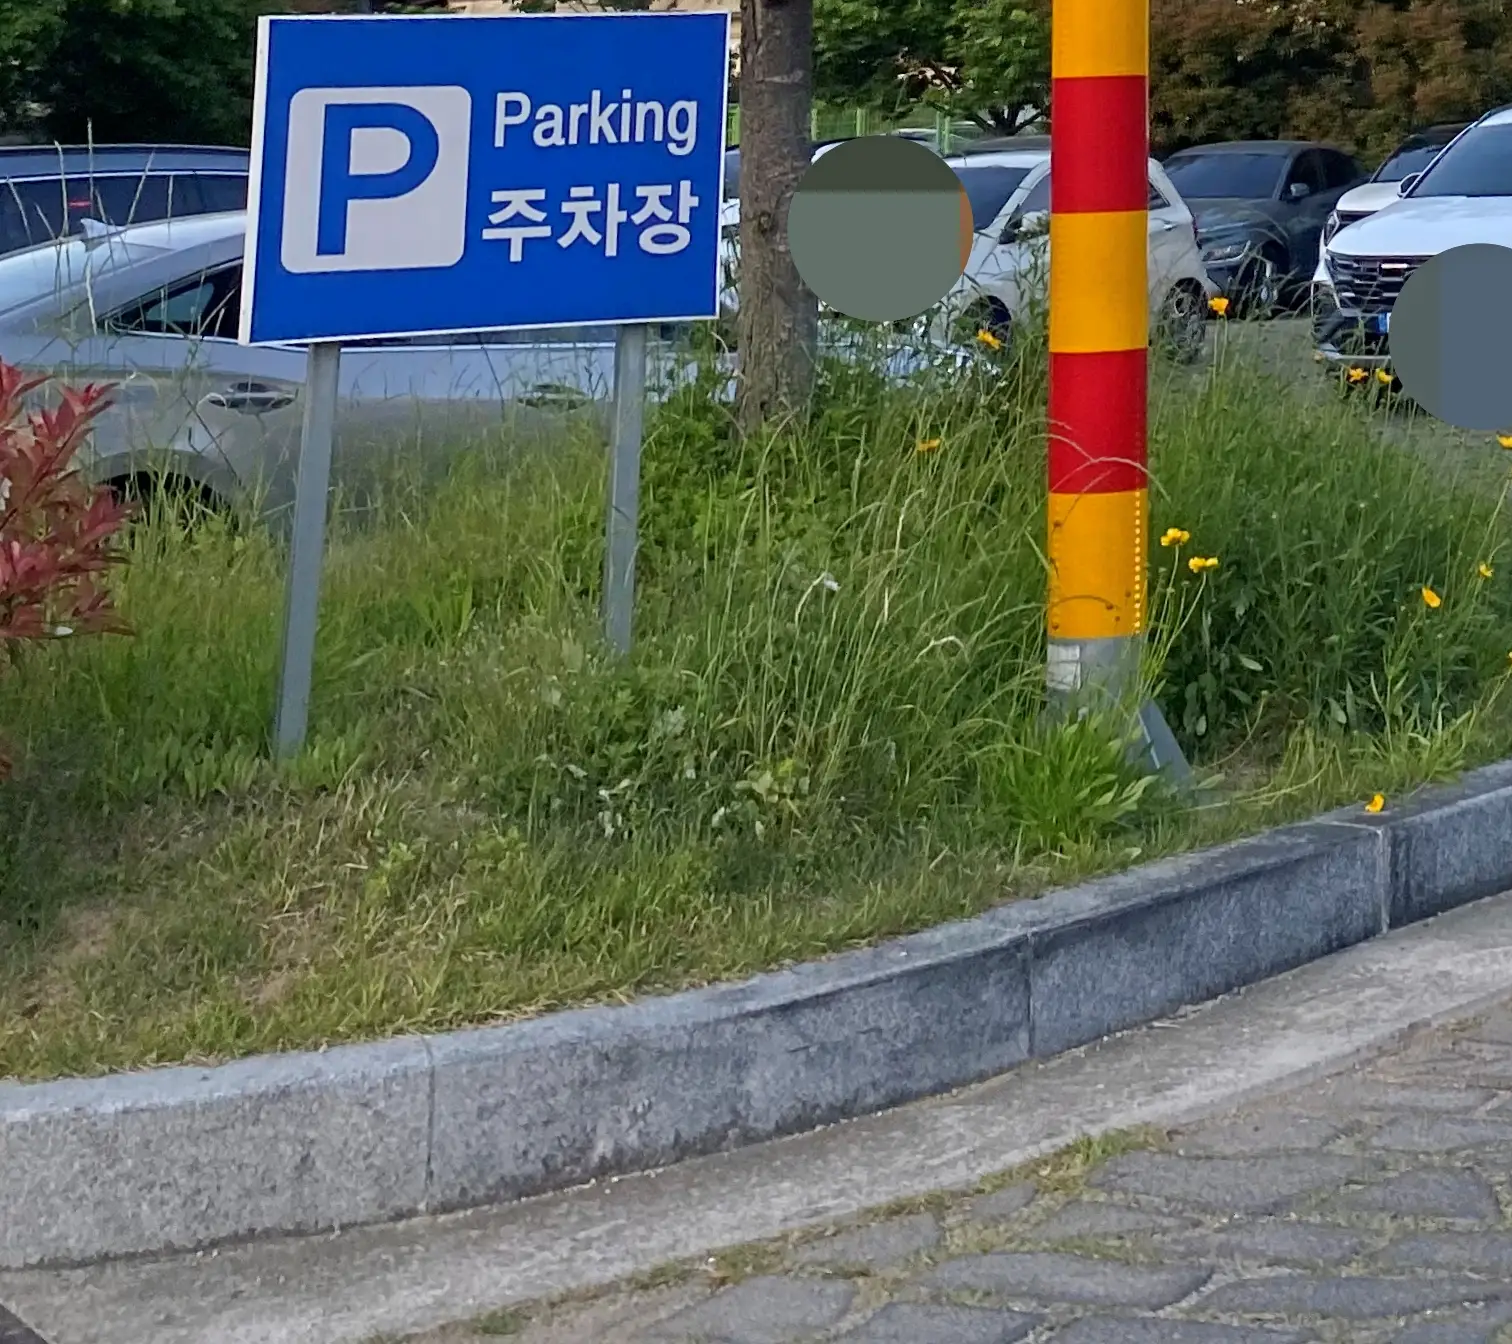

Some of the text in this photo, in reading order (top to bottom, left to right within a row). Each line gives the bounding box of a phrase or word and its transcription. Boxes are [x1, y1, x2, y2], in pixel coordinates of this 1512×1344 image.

[494, 88, 698, 156] Parking
[316, 102, 440, 256] P
[481, 179, 699, 263] 주차장
